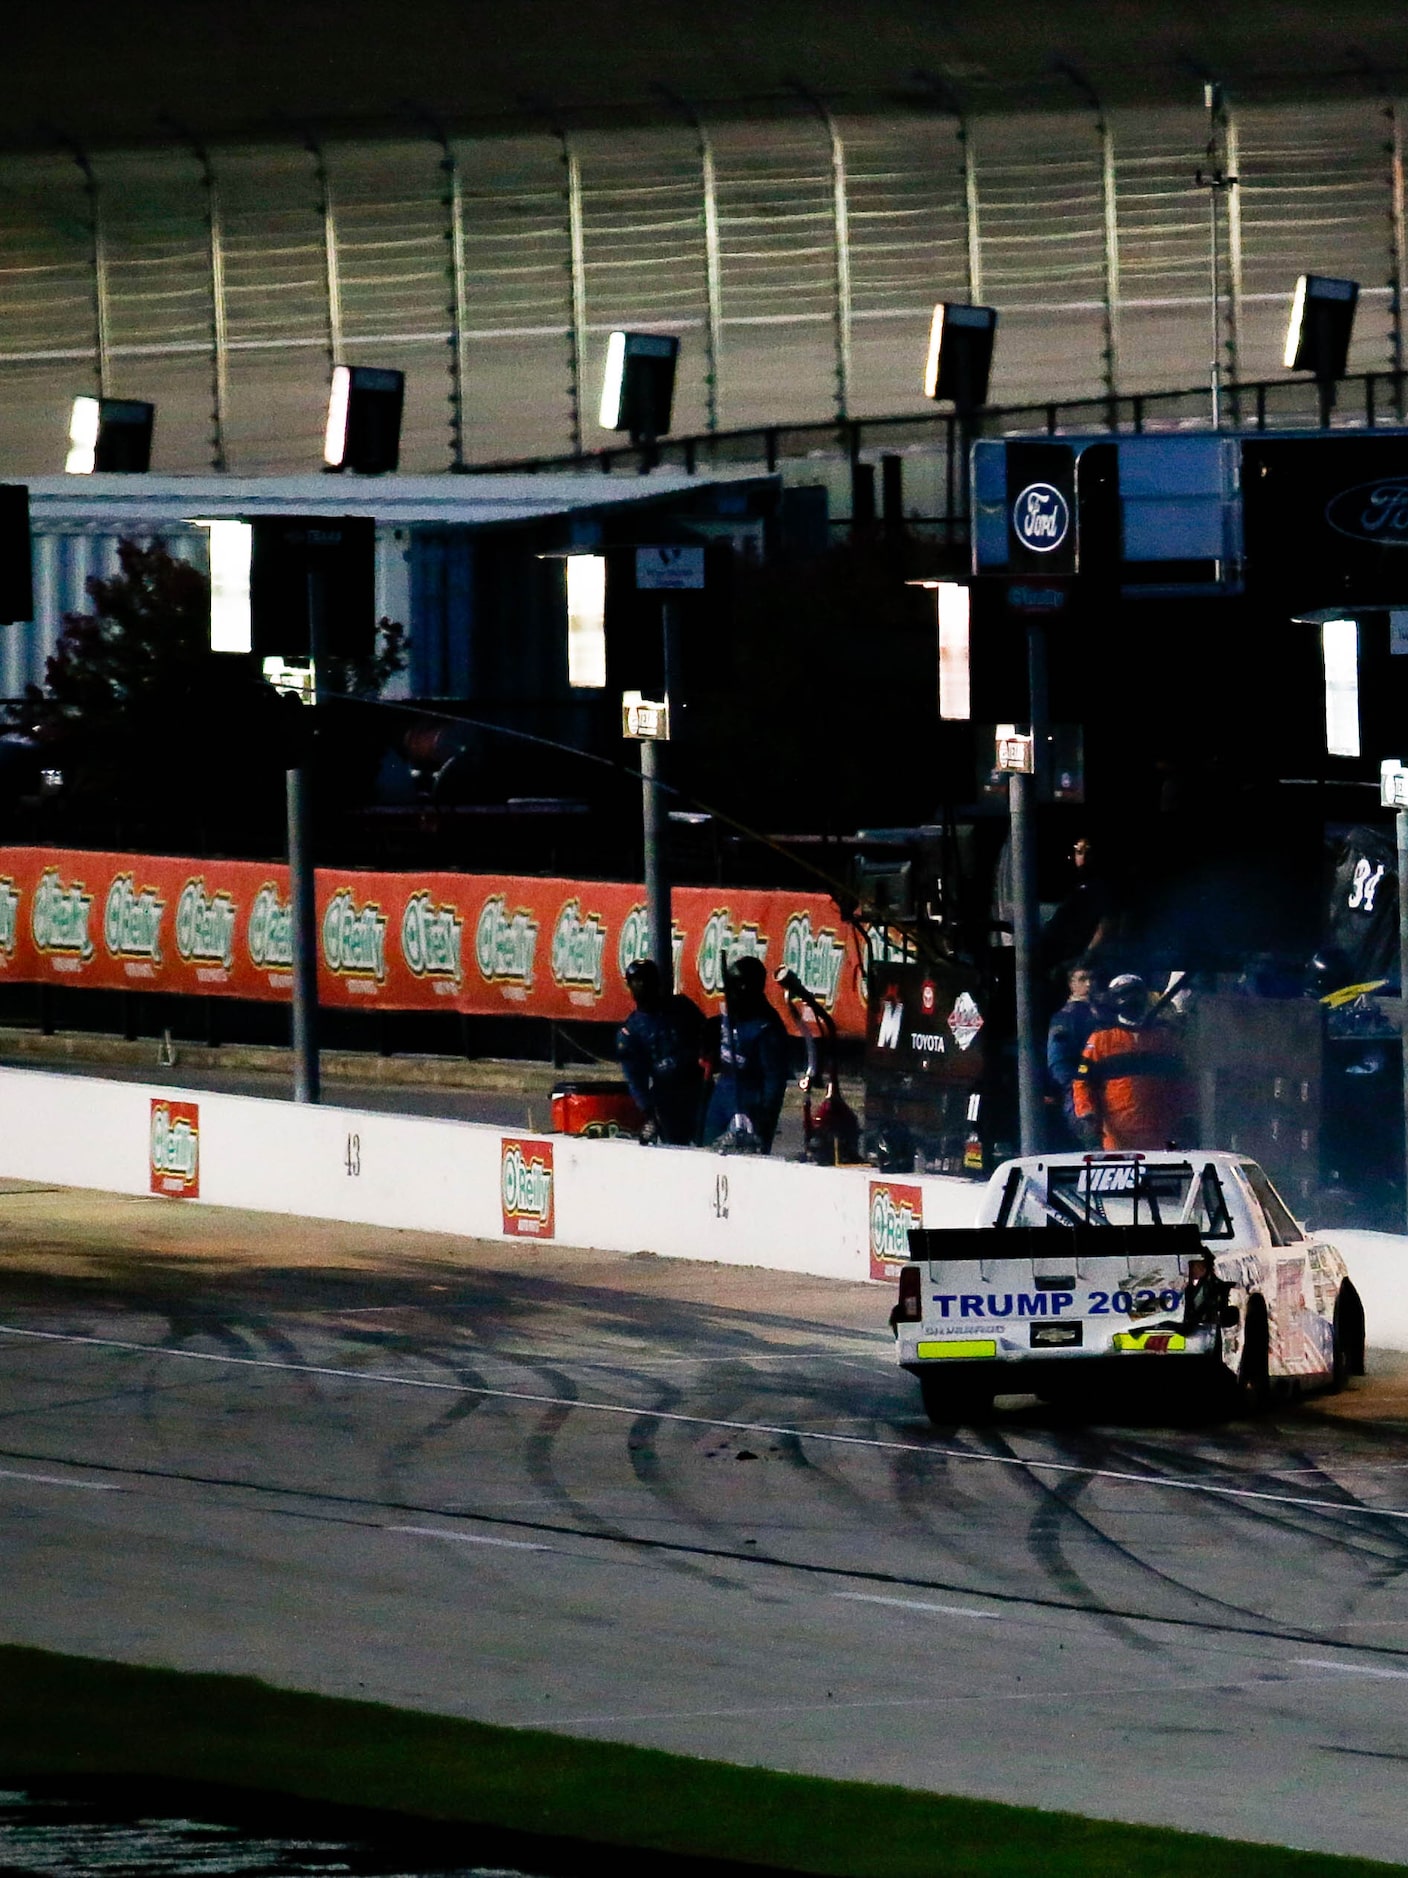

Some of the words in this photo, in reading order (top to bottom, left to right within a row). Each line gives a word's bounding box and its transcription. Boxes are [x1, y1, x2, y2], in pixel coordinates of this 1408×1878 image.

[1023, 491, 1059, 537] Ford
[1349, 858, 1384, 912] 34
[911, 1032, 945, 1053] TOYOTA
[344, 1132, 361, 1177] 43
[503, 1150, 551, 1221] O'Reilly
[713, 1174, 729, 1219] 42
[1077, 1165, 1147, 1193] VIENS
[932, 1292, 1075, 1318] TRUMP
[1087, 1288, 1182, 1316] 2020
